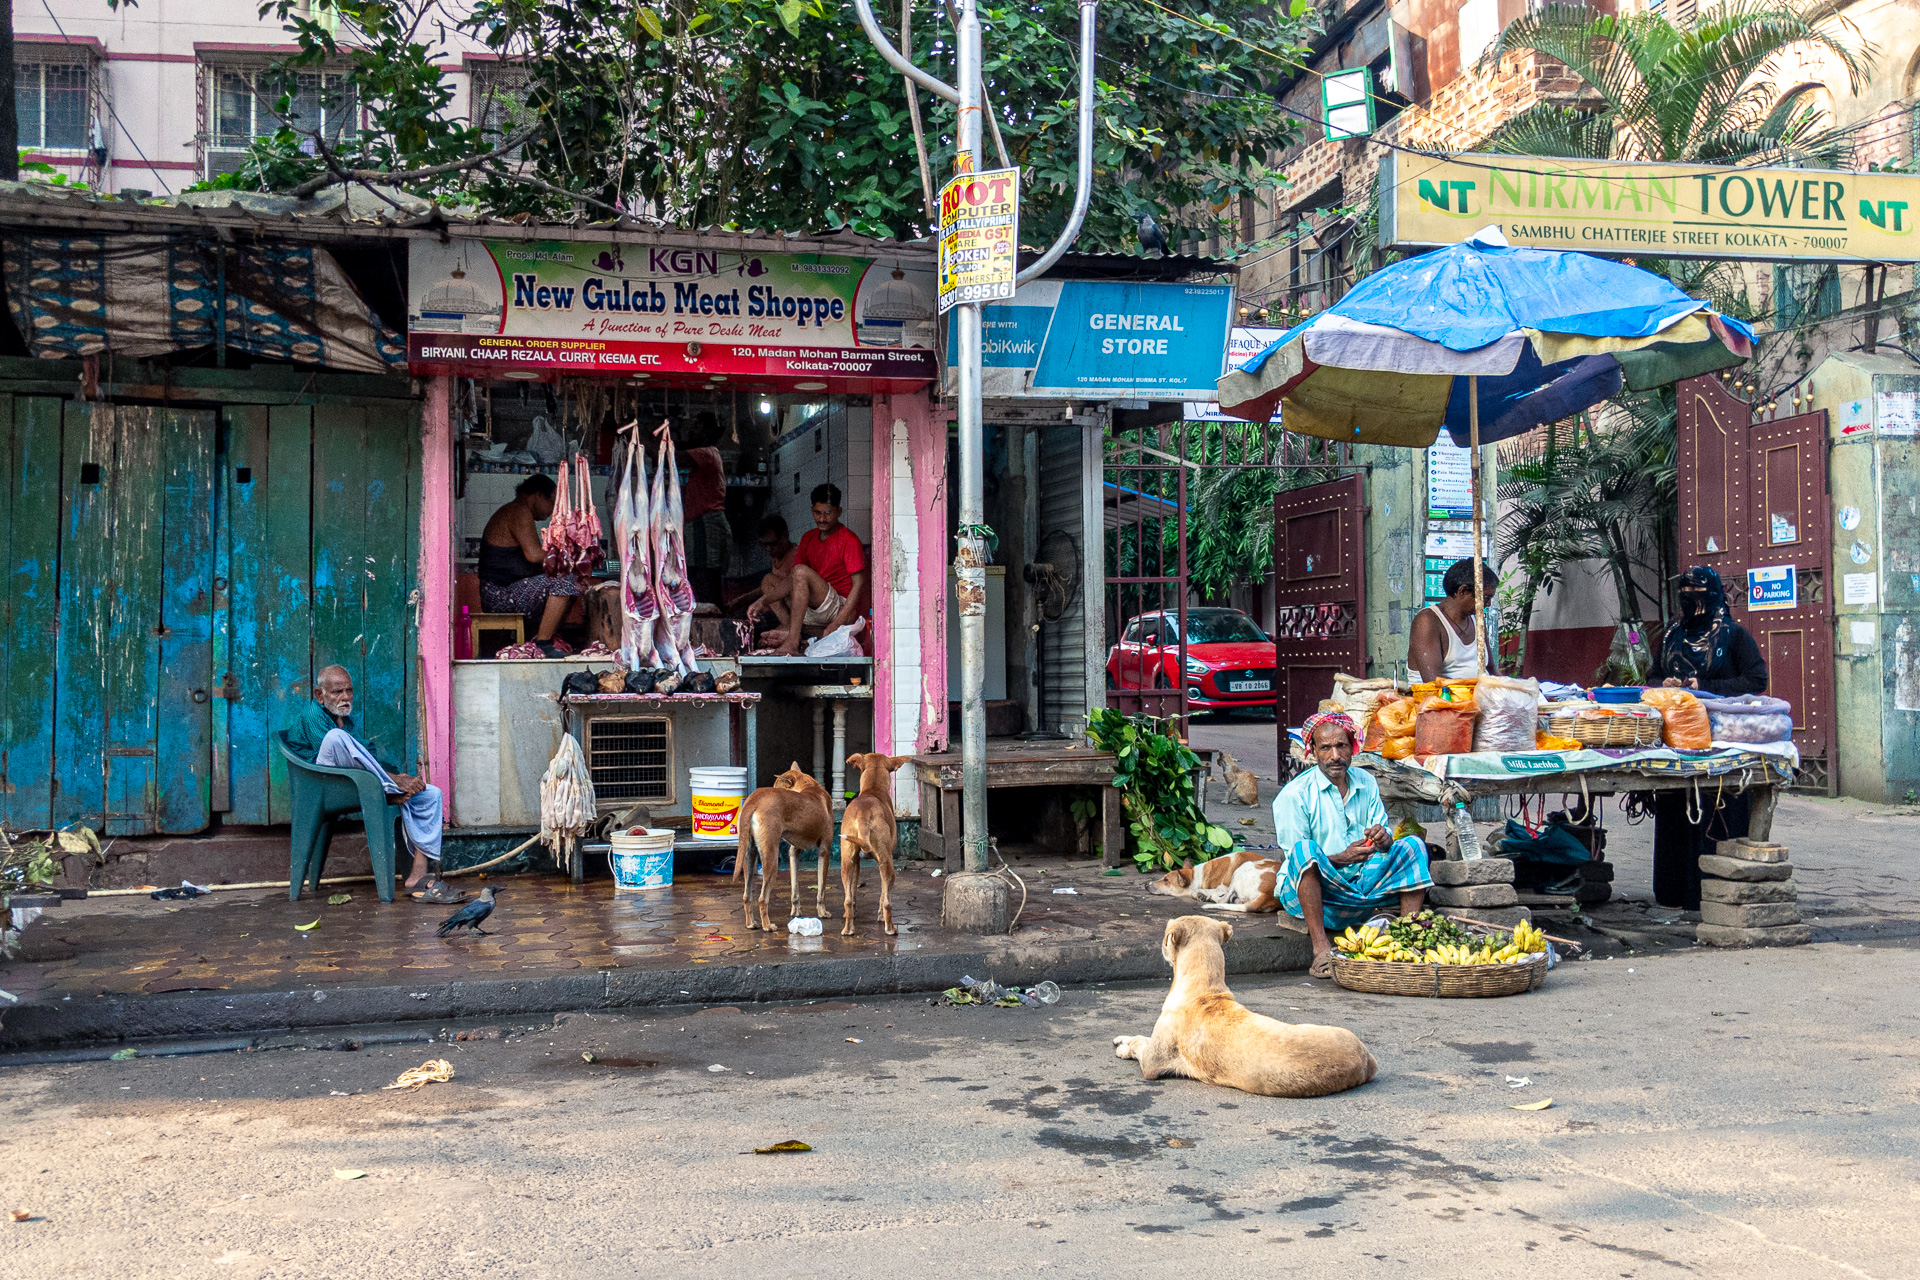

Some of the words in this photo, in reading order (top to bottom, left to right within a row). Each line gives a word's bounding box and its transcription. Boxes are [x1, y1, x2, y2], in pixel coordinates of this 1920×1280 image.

[942, 177, 1011, 217] ROOT
[1418, 178, 1476, 214] NT
[1488, 165, 1677, 214] NIRMAN
[1693, 174, 1846, 221] TOWER
[941, 203, 1011, 228] COMPUTER
[1859, 199, 1909, 232] NT
[984, 226, 1012, 240] GST
[1511, 224, 1576, 240] SAMBHU
[1581, 226, 1667, 245] CHATTERJEE
[1673, 230, 1719, 245] STREET
[1725, 232, 1788, 248] KOLKATA
[1803, 236, 1848, 250] 700007
[552, 252, 574, 262] Alam
[649, 248, 718, 274] KGN
[950, 248, 989, 267] SPOKEN
[514, 274, 575, 310] New
[582, 277, 667, 314] Gulab
[673, 281, 741, 317] Meat
[748, 284, 845, 328] Shoppe
[940, 281, 1009, 311] 98301-99516
[581, 318, 596, 332] A
[599, 318, 652, 336] Junction
[655, 321, 669, 338] of
[672, 321, 704, 336] Pure
[708, 322, 744, 336] Deshi
[748, 323, 783, 338] Meat
[981, 321, 996, 329] ERE
[998, 321, 1018, 329] WITH
[1089, 313, 1185, 332] GENERAL
[479, 338, 524, 347] GENERAL
[526, 339, 559, 349] ORDER
[561, 340, 606, 350] SUPPLIER
[1101, 337, 1169, 355] STORE
[599, 353, 637, 364] KEEMA
[639, 354, 662, 365] ETC.
[731, 347, 756, 359] 120,
[757, 348, 797, 358] Madan
[799, 348, 839, 359] Mohan
[841, 349, 886, 361] Barman
[887, 351, 925, 362] Street,
[786, 360, 873, 372] Kolkata-700007
[1763, 590, 1791, 599] PARKING
[1771, 582, 1782, 590] NO
[1507, 760, 1527, 769] Milk
[1527, 760, 1560, 769] Lachha
